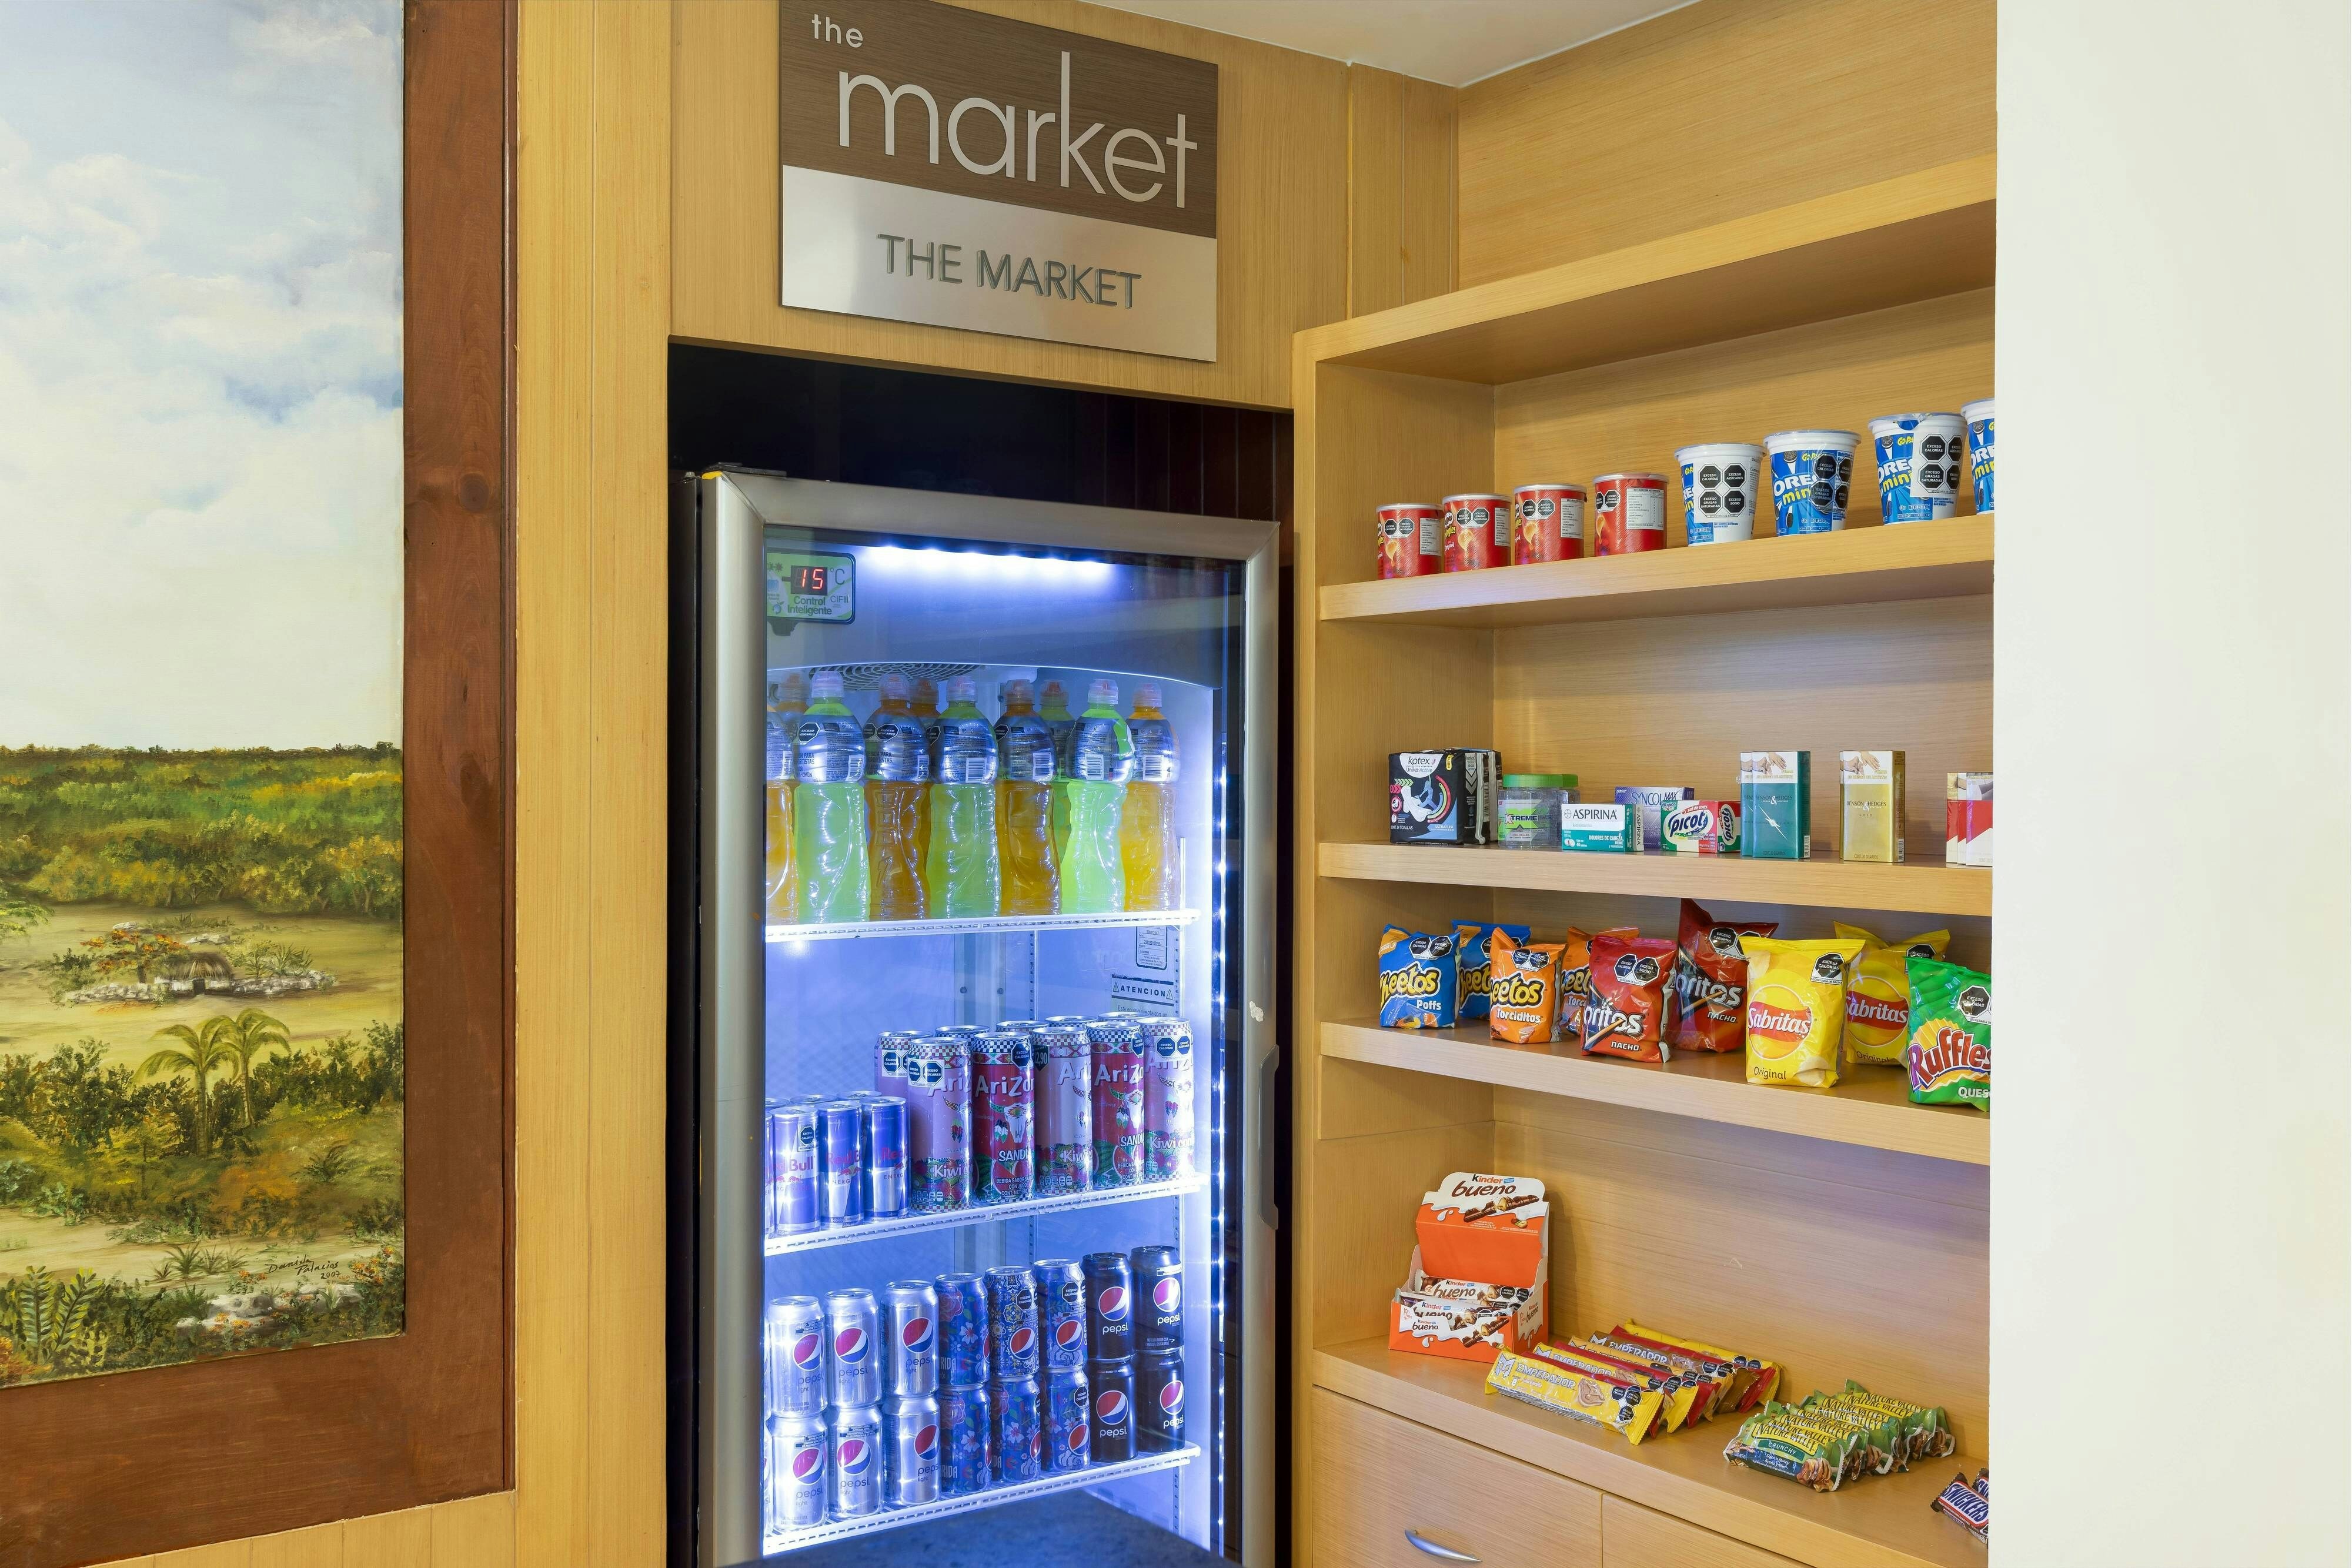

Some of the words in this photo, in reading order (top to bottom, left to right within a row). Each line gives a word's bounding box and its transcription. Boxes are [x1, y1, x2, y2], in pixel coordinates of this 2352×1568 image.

[811, 14, 863, 48] the
[839, 51, 1198, 208] market
[877, 233, 962, 284] THE
[976, 250, 1142, 309] MARKET
[801, 568, 824, 590] 15
[794, 596, 826, 606] Control
[787, 606, 832, 616] Inteligente
[1408, 756, 1430, 765] kotex
[1631, 793, 1662, 805] SYNCOL
[1664, 792, 1678, 800] MAX
[1770, 796, 1777, 806] &
[1573, 809, 1617, 820] ASPIRINA
[1670, 811, 1706, 837] picot
[1120, 985, 1165, 997] ATENCION
[1380, 966, 1438, 1008] heetos
[1491, 977, 1541, 1004] eetos
[1676, 974, 1742, 1007] oritos
[1416, 999, 1441, 1010] Poffs
[1497, 1009, 1541, 1024] Torciditos
[1584, 1003, 1642, 1034] oritos
[1748, 1008, 1810, 1034] Sabritas
[1857, 1051, 1890, 1063] Original
[1909, 1028, 1991, 1091] Ruffles
[1754, 1066, 1786, 1079] Original
[1959, 1087, 1991, 1098] QUES
[1150, 1136, 1175, 1149] Kiwi
[789, 1156, 814, 1171] Bull
[933, 1165, 961, 1178] Kiwi
[1452, 1181, 1516, 1197] bueno
[295, 1261, 339, 1275] Palacios
[321, 1271, 341, 1279] 2007
[1433, 1285, 1476, 1298] bueno
[1157, 1312, 1180, 1326] pepsi
[1526, 1305, 1539, 1322] bueno
[1102, 1322, 1128, 1335] pepsi
[1609, 1341, 1668, 1364] EMPERADOR
[906, 1356, 933, 1367] pepsi
[941, 1358, 957, 1370] RIDA
[798, 1373, 823, 1385] pepsi
[838, 1366, 868, 1378] pepsi
[1516, 1363, 1576, 1390] EMPERADOR
[1849, 1396, 1881, 1407] NATURE
[1882, 1404, 1911, 1417] VALLEY
[1866, 1394, 1896, 1405] NATURE
[1825, 1399, 1857, 1413] NATURE
[1858, 1409, 1888, 1422] VALLEY
[1164, 1415, 1184, 1429] pepsi
[1818, 1407, 1849, 1420] NATURE
[1852, 1415, 1880, 1430] VALLEY
[1100, 1426, 1127, 1437] pepsi
[1769, 1420, 1802, 1432] NATURE
[1805, 1429, 1833, 1445] VALLEY
[1783, 1415, 1818, 1429] NATURE
[1818, 1423, 1849, 1439] VALLEY
[1756, 1423, 1790, 1438] NATURE
[1790, 1433, 1816, 1452] VALLEY
[1768, 1442, 1797, 1455] CRUNCHY
[940, 1465, 957, 1478] RIDA
[840, 1477, 870, 1489] pepsi
[796, 1486, 823, 1500] pepsi
[1940, 1483, 1989, 1522] SNICKERS
